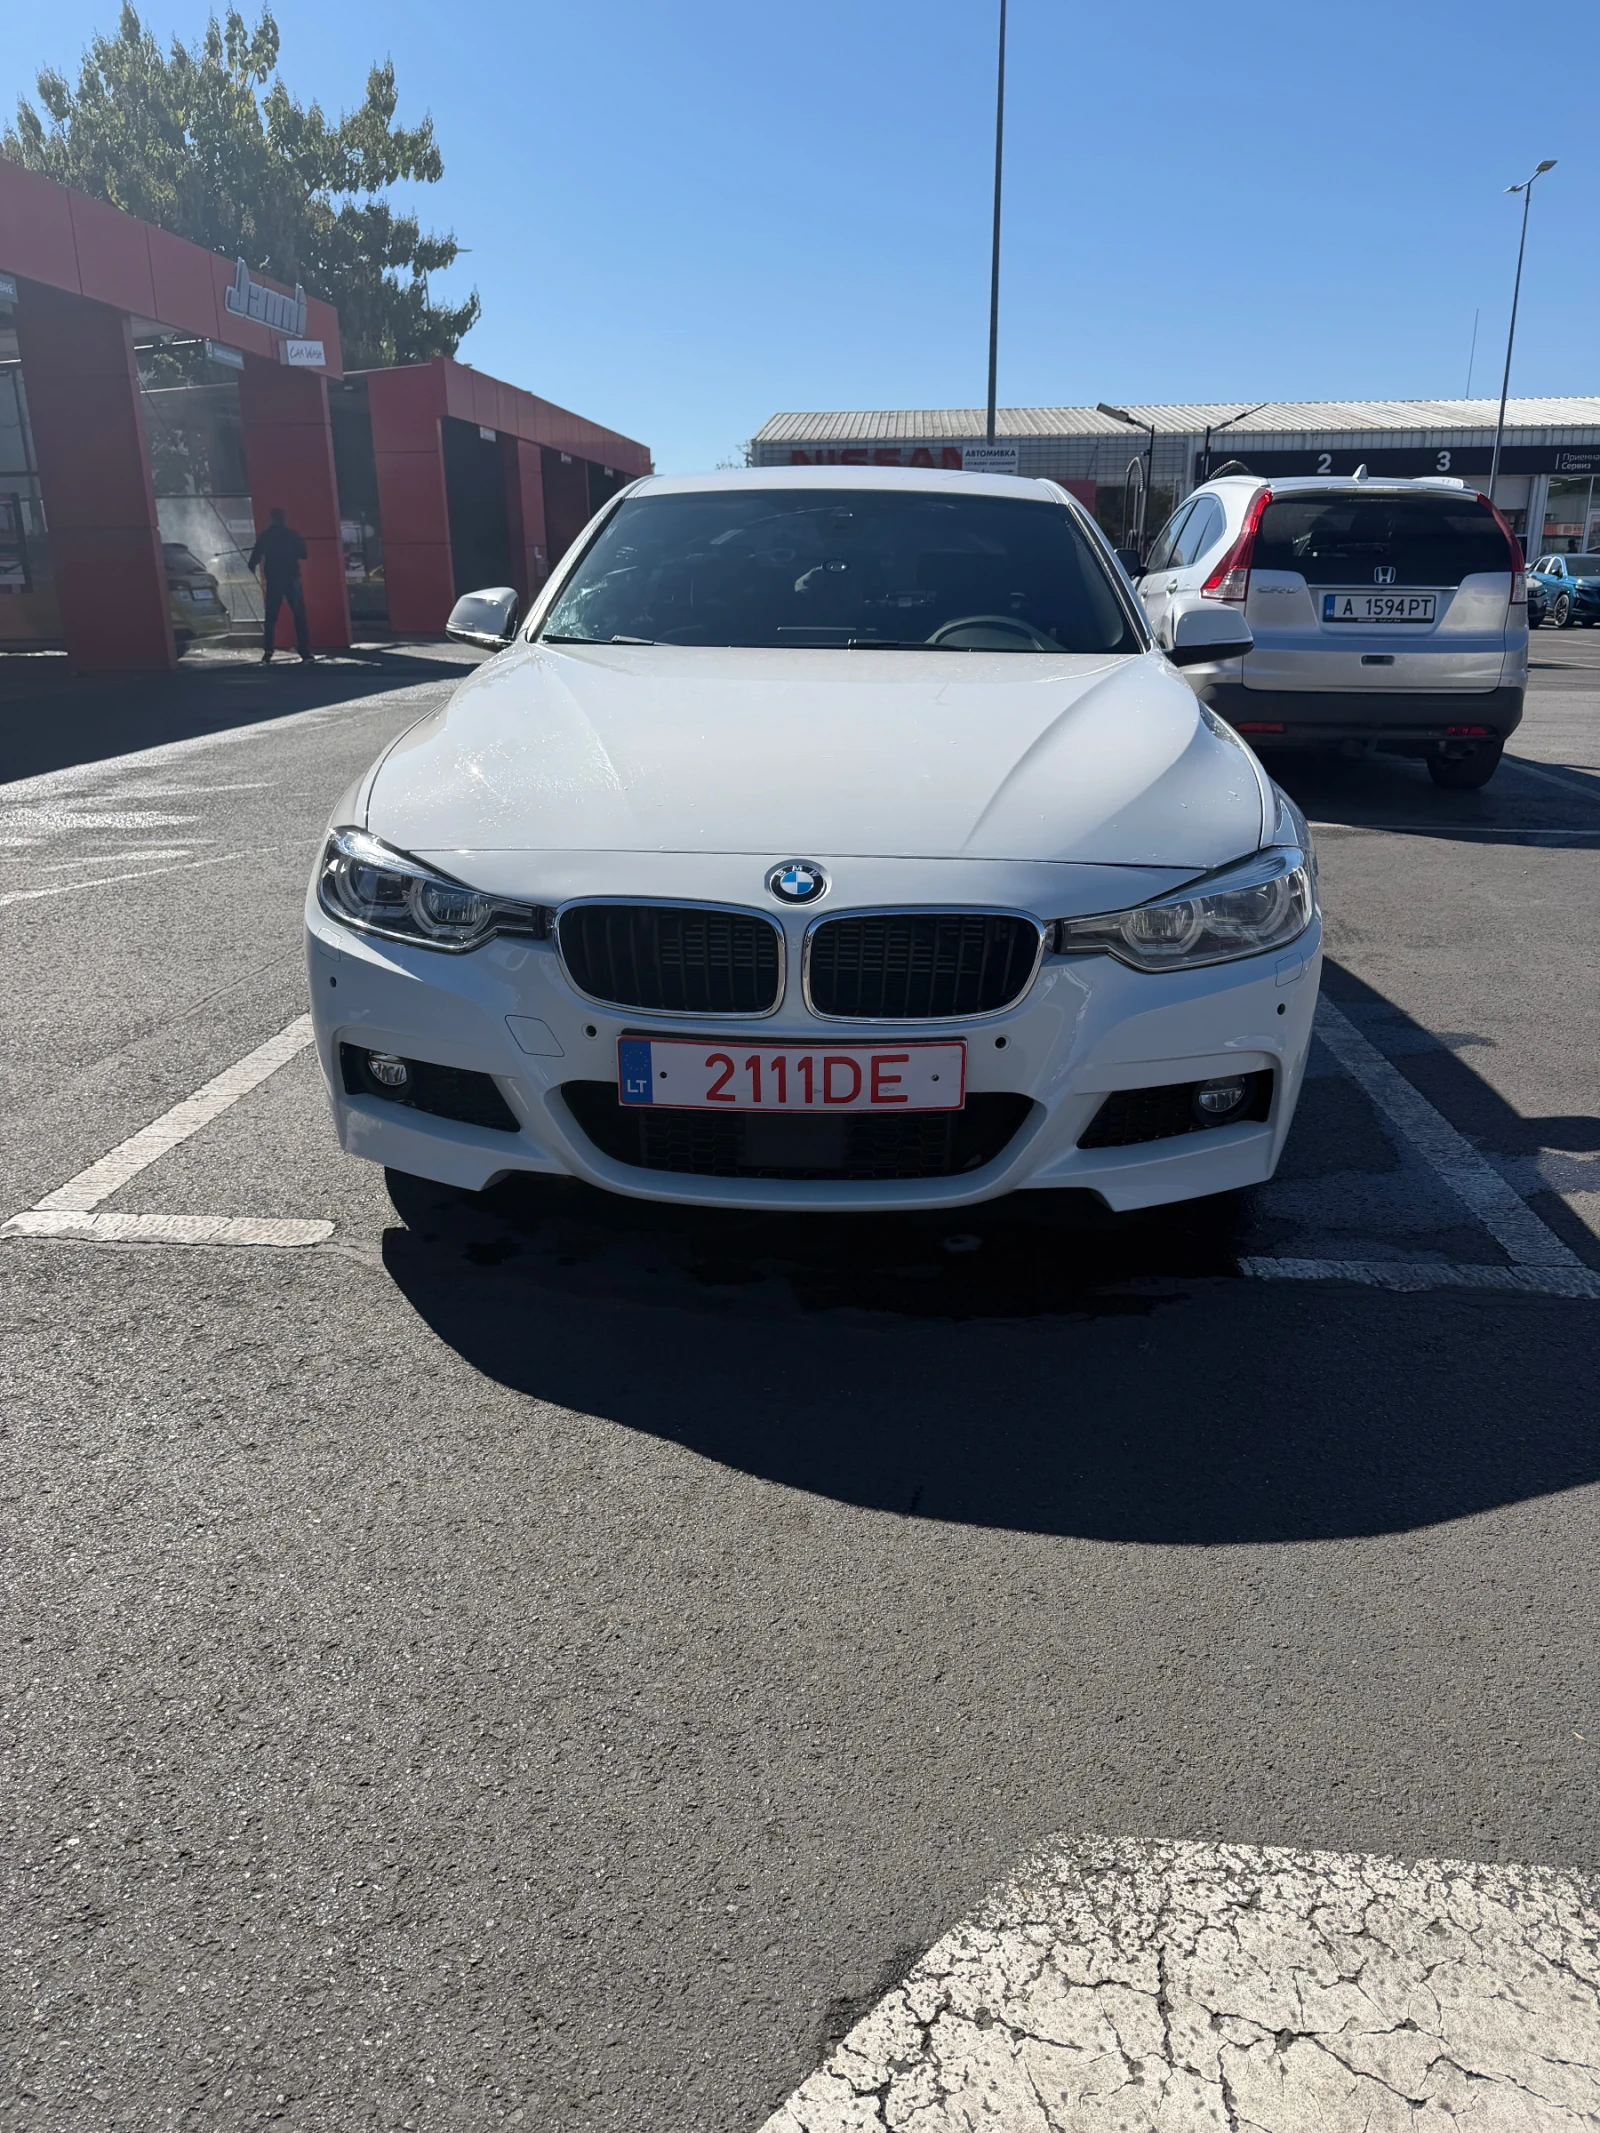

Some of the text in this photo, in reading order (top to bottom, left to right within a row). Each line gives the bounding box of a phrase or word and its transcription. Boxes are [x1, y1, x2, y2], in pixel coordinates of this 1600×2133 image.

[965, 449, 1016, 457] АВТОМИВКА
[1436, 450, 1451, 472] 3
[1316, 453, 1332, 474] 2
[1561, 461, 1592, 471] Сервиз
[1342, 598, 1354, 616] A
[627, 1053, 909, 1104] LT 2111DE
